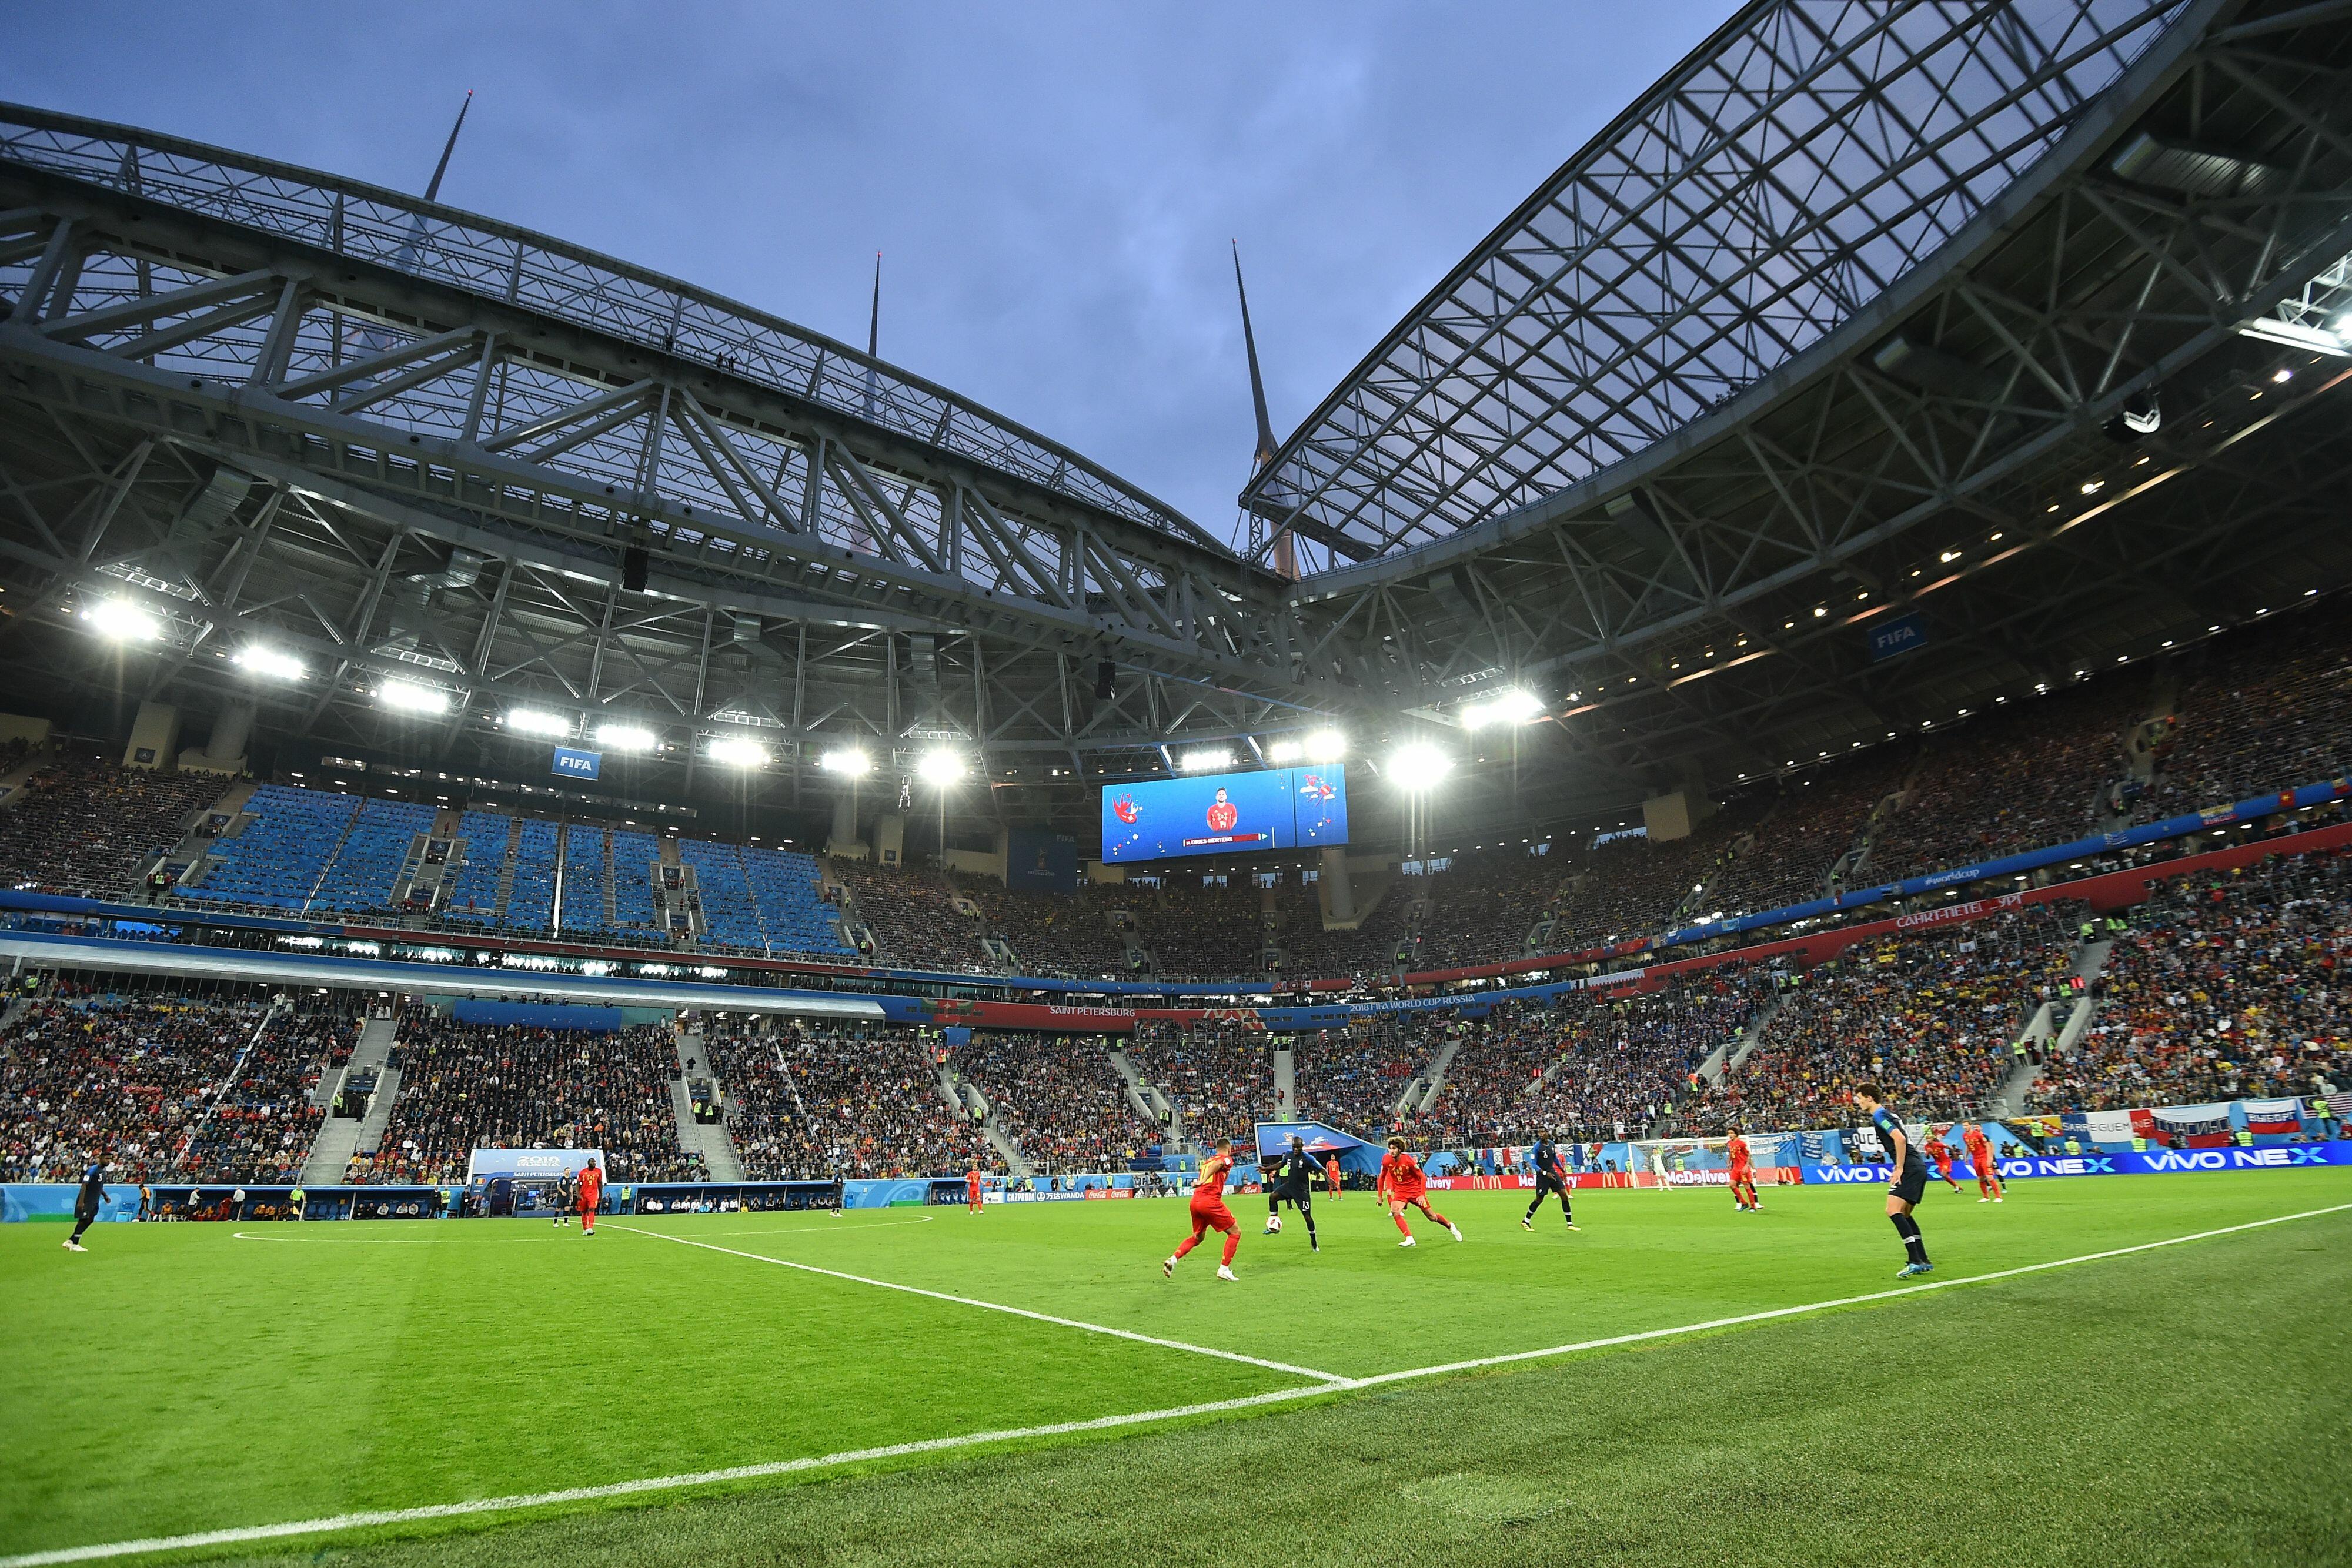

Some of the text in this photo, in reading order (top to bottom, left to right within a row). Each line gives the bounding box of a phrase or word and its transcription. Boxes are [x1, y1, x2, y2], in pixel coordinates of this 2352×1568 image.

[1877, 626, 1916, 648] FIFA
[560, 756, 592, 771] FIFA
[1056, 834, 1075, 843] FIFA
[1925, 868, 1980, 887] #worldcup
[1370, 1003, 1389, 1011] FIFA
[1390, 999, 1422, 1009] WORLD
[1422, 998, 1441, 1007] CUP
[1442, 994, 1476, 1004] RUSSIA
[1050, 1006, 1136, 1017] SAINT PETERSBURG
[2247, 1111, 2296, 1122] ВЫБОРГ
[1494, 1154, 1502, 1162] 33
[2233, 1146, 2328, 1166] NEX
[2037, 1157, 2116, 1175] NEX
[1426, 1177, 1452, 1190] livery
[1007, 1192, 1034, 1202] GAZPROM
[1088, 1190, 1107, 1199] Coca-Cola
[1111, 1189, 1130, 1198] Coca-Cola
[1302, 1201, 1309, 1210] 13
